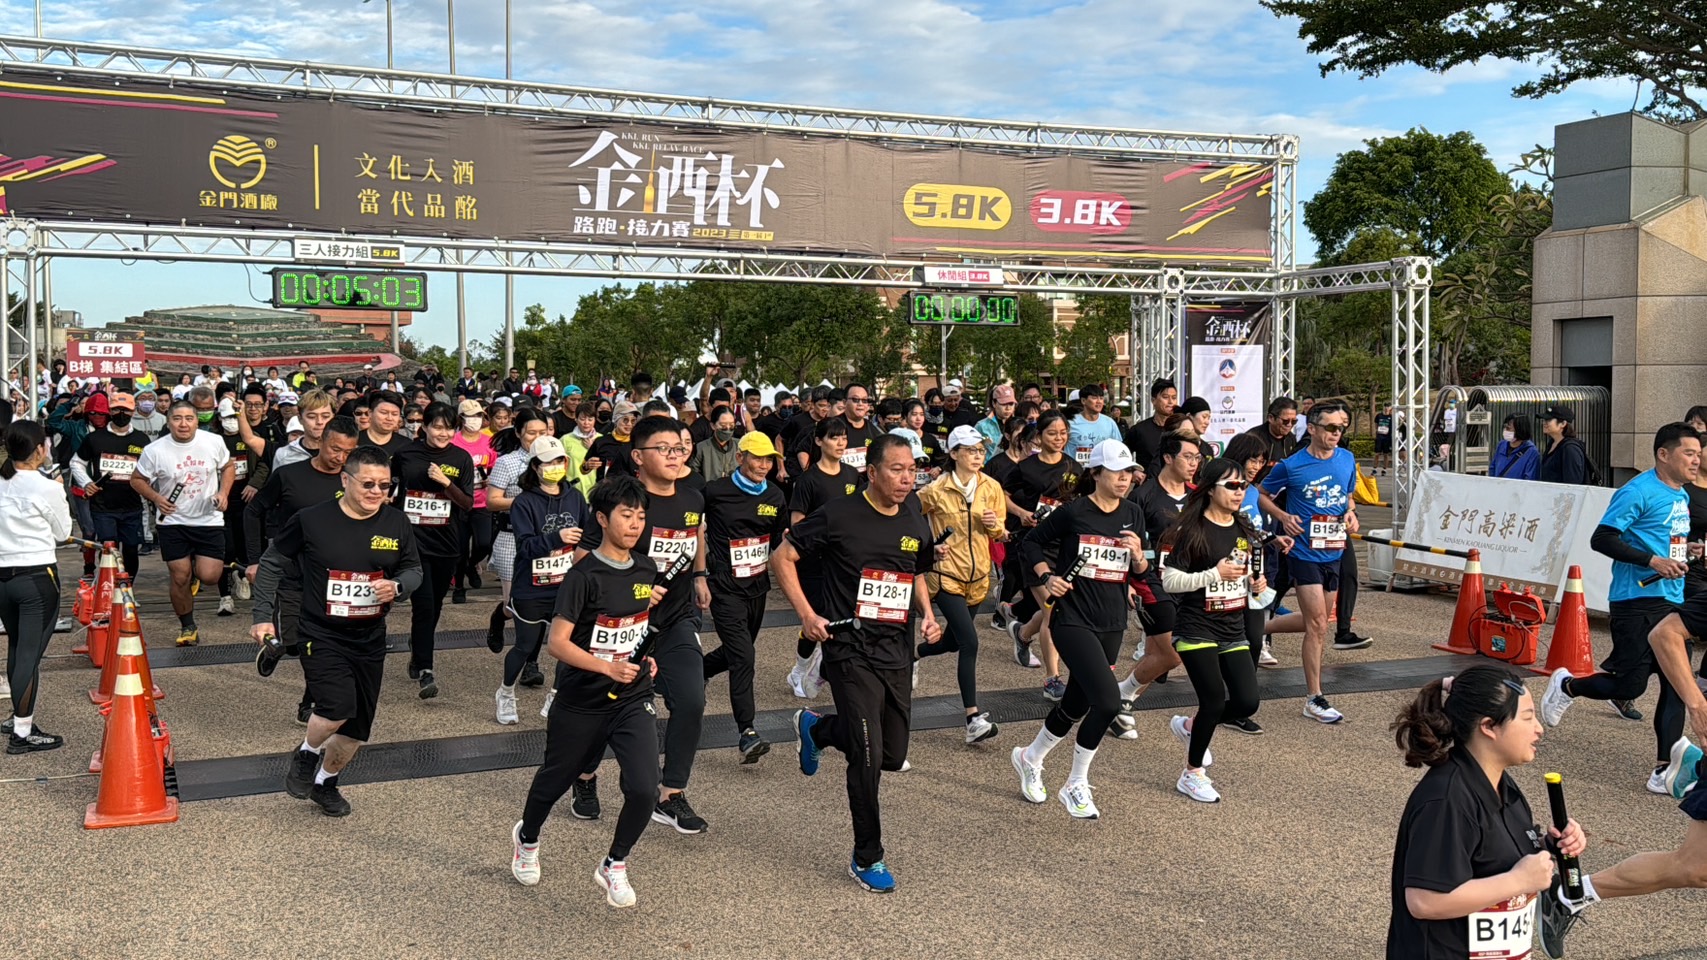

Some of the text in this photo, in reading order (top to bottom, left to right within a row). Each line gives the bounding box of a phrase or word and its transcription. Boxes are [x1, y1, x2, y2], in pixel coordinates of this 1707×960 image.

[641, 133, 661, 142] RUN
[353, 151, 475, 186] 文化入酒
[198, 189, 278, 211] 金門酒廠
[356, 187, 479, 221] 當代品酩
[911, 190, 1003, 223] 5.8K
[1037, 196, 1123, 227] 3.8K
[692, 228, 727, 239] 2023
[299, 242, 369, 259] 三人接力組
[280, 272, 422, 307] 00:05:03
[88, 345, 124, 355] 5.8K
[69, 360, 143, 374] B梯 集結區
[102, 460, 135, 470] B222-1
[407, 498, 448, 511] B216-1
[1438, 503, 1541, 543] 金門高粱酒
[653, 540, 695, 554] B220-1
[733, 545, 768, 561] B146-1
[1082, 546, 1128, 563] B149-1
[331, 583, 375, 598] B123-
[862, 582, 908, 600] B128-1
[595, 624, 645, 645] B190-1
